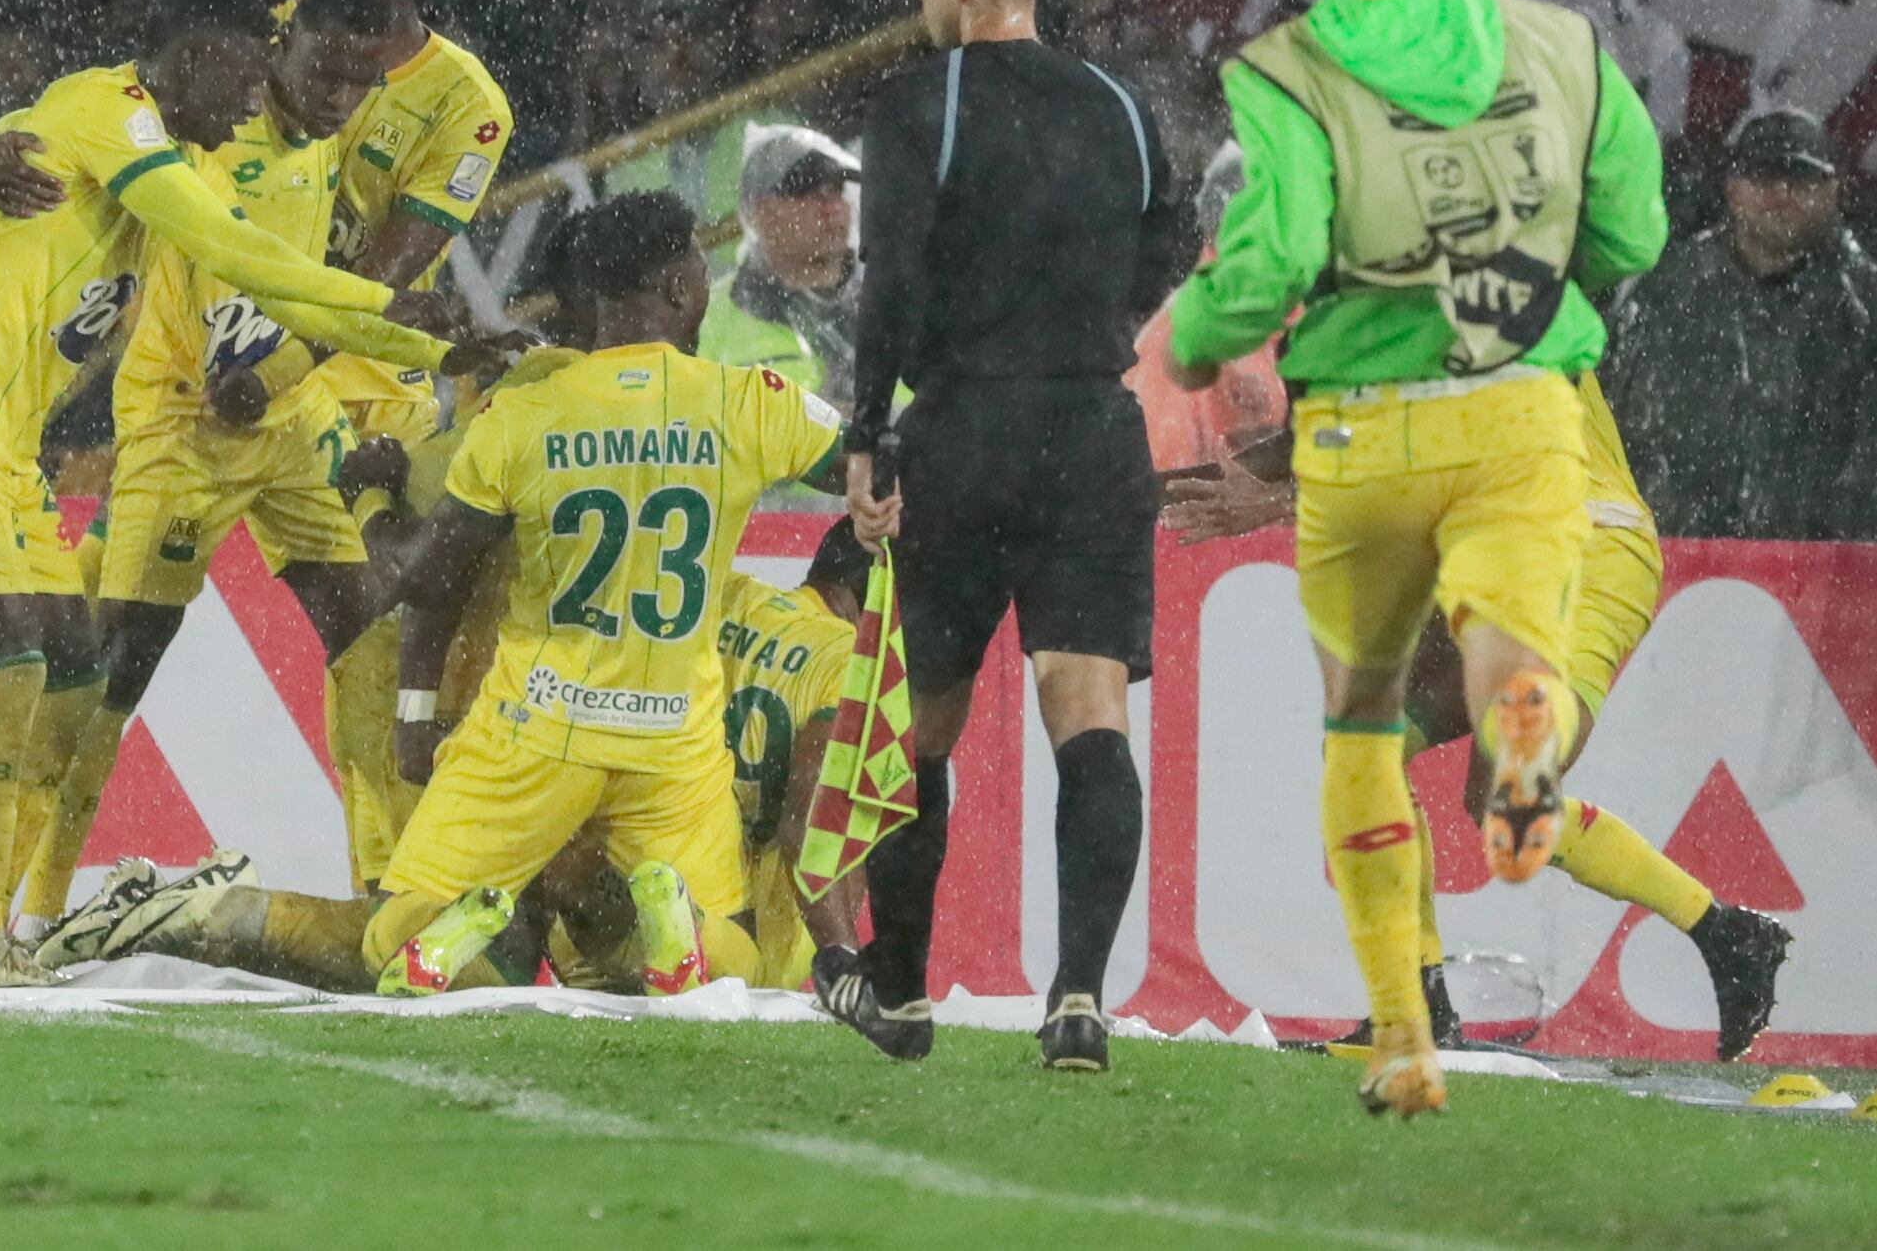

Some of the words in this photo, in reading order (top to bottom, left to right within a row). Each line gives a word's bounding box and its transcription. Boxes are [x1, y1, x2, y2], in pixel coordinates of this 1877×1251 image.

[544, 420, 717, 470] ROMAÑA
[551, 487, 711, 641] 23
[717, 621, 811, 674] ENAO
